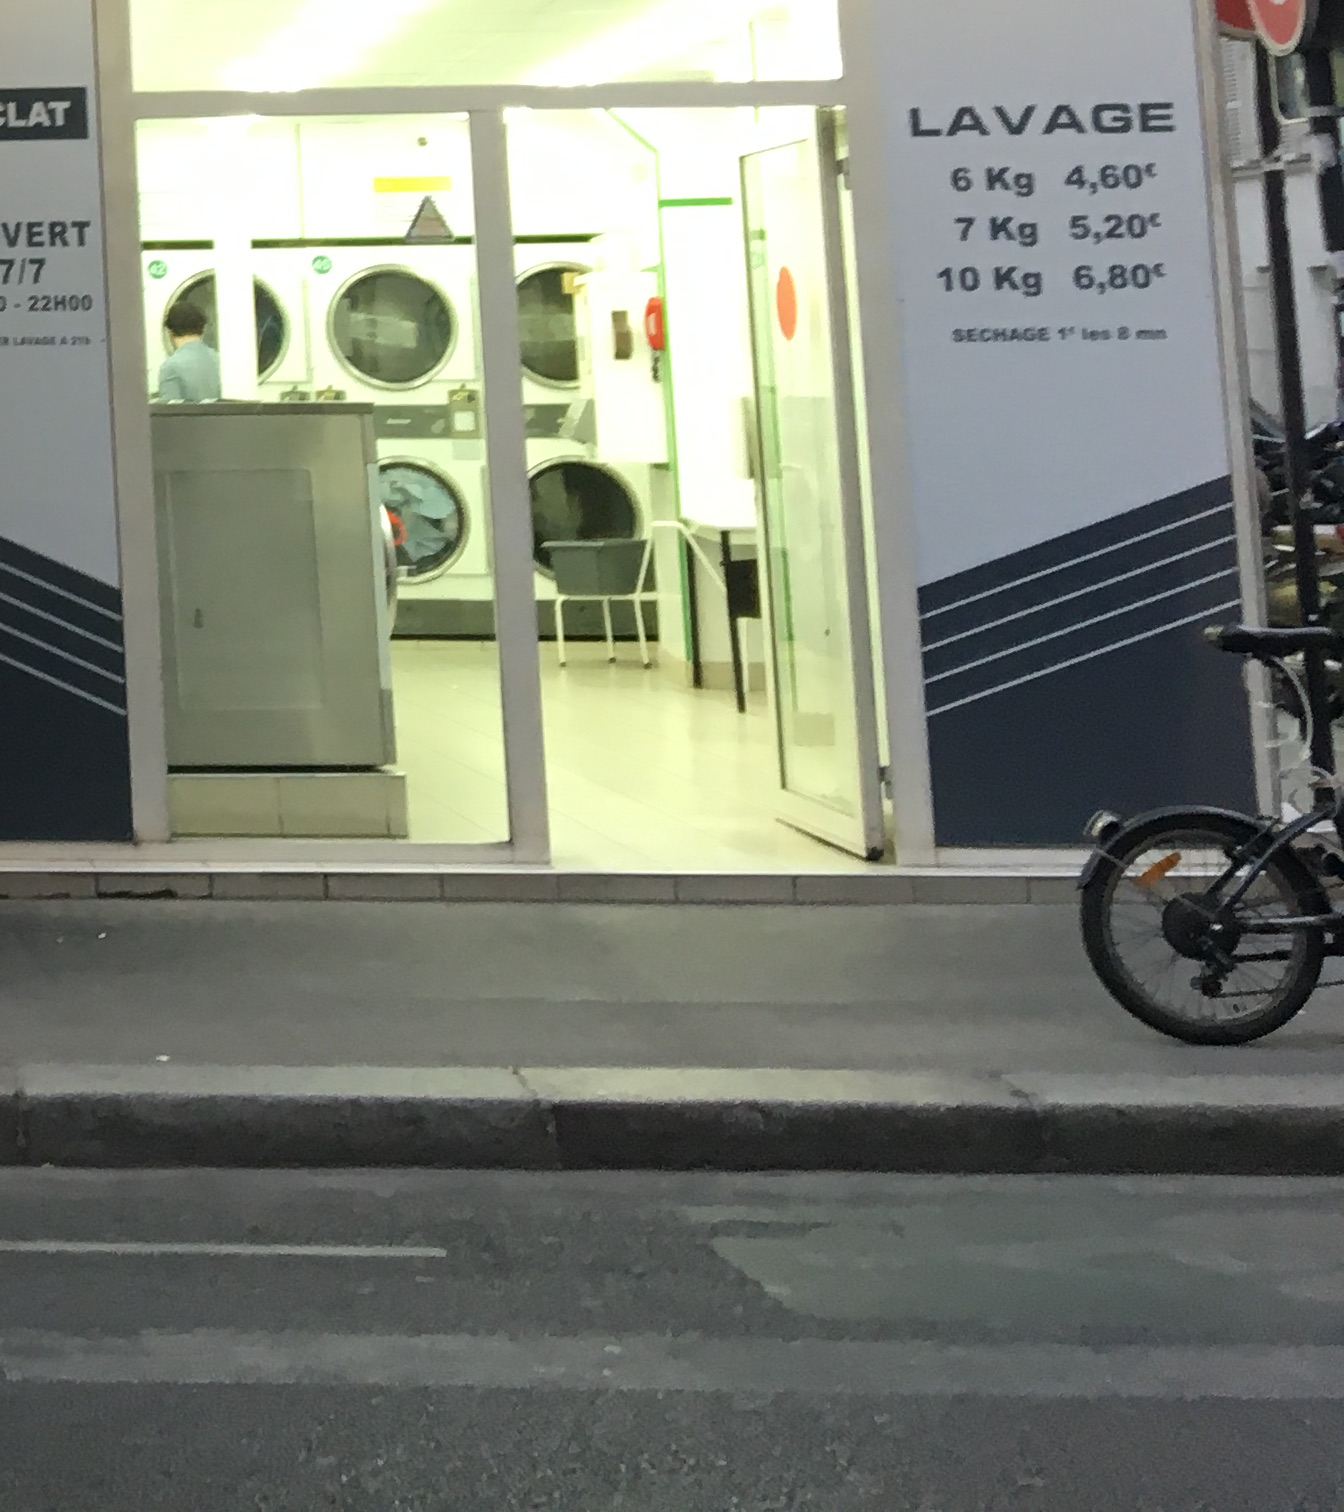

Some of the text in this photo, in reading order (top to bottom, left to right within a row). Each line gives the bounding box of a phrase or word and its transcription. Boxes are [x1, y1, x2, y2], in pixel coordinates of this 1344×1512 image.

[910, 103, 1175, 137] LAVAGE
[951, 168, 972, 192] 6
[986, 167, 1035, 197] Kg
[955, 217, 975, 241] 7
[989, 217, 1038, 247] Kg
[937, 267, 980, 291] 10
[994, 266, 1042, 297] Kg
[28, 295, 92, 312] 22H00
[953, 327, 1050, 342] SECHAGE
